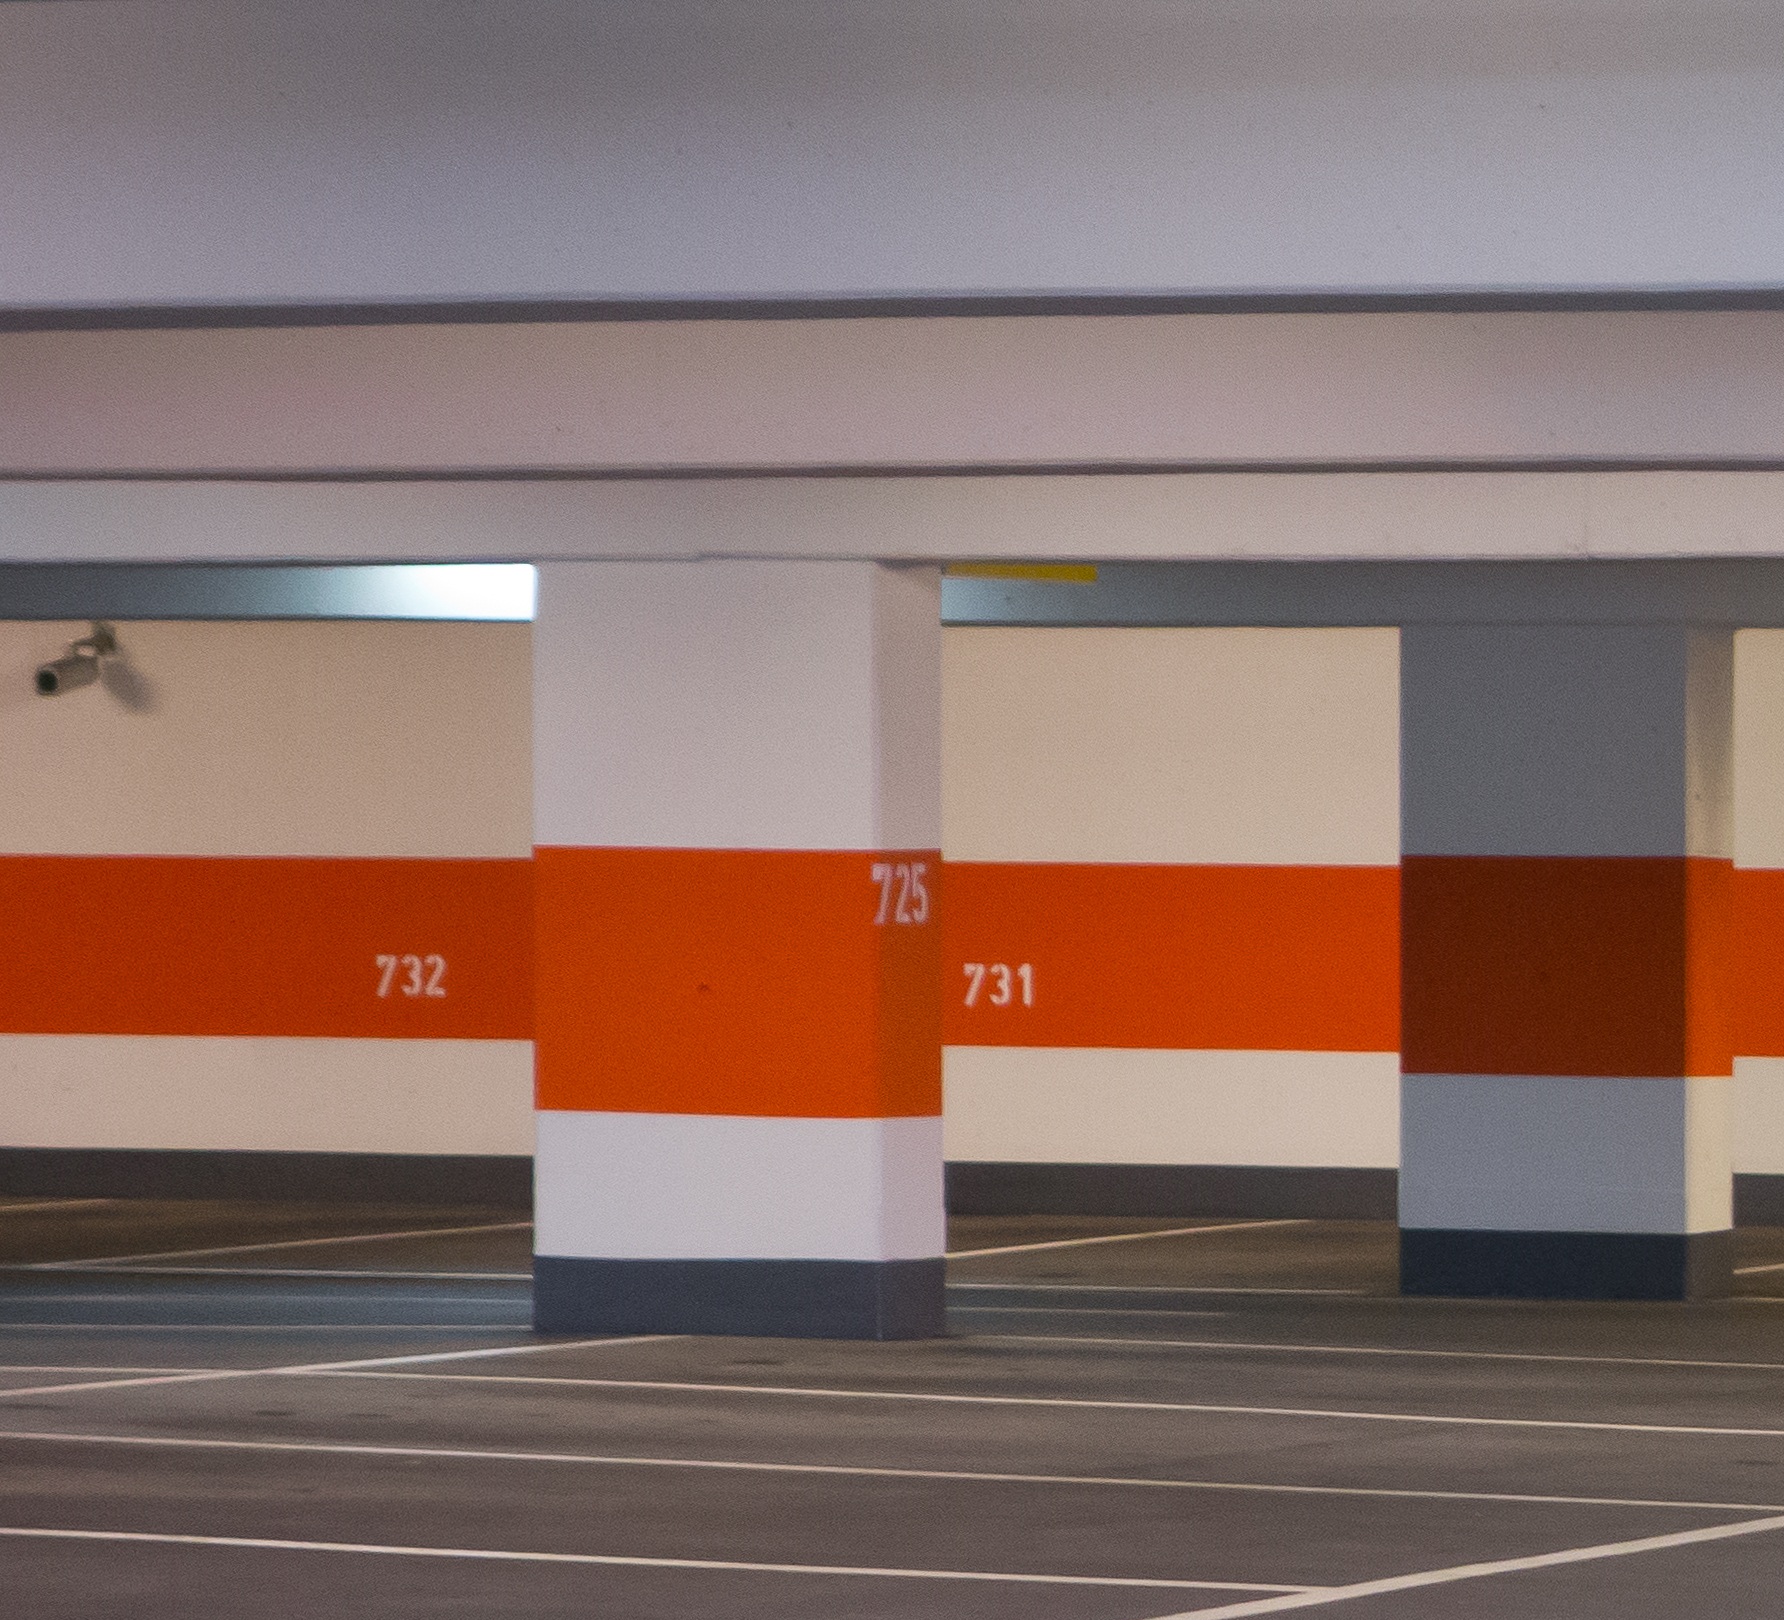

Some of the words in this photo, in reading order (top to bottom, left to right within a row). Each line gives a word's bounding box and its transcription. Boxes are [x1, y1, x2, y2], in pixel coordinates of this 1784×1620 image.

[871, 863, 928, 924] 725
[376, 954, 447, 998] 732
[963, 963, 1034, 1007] 731
